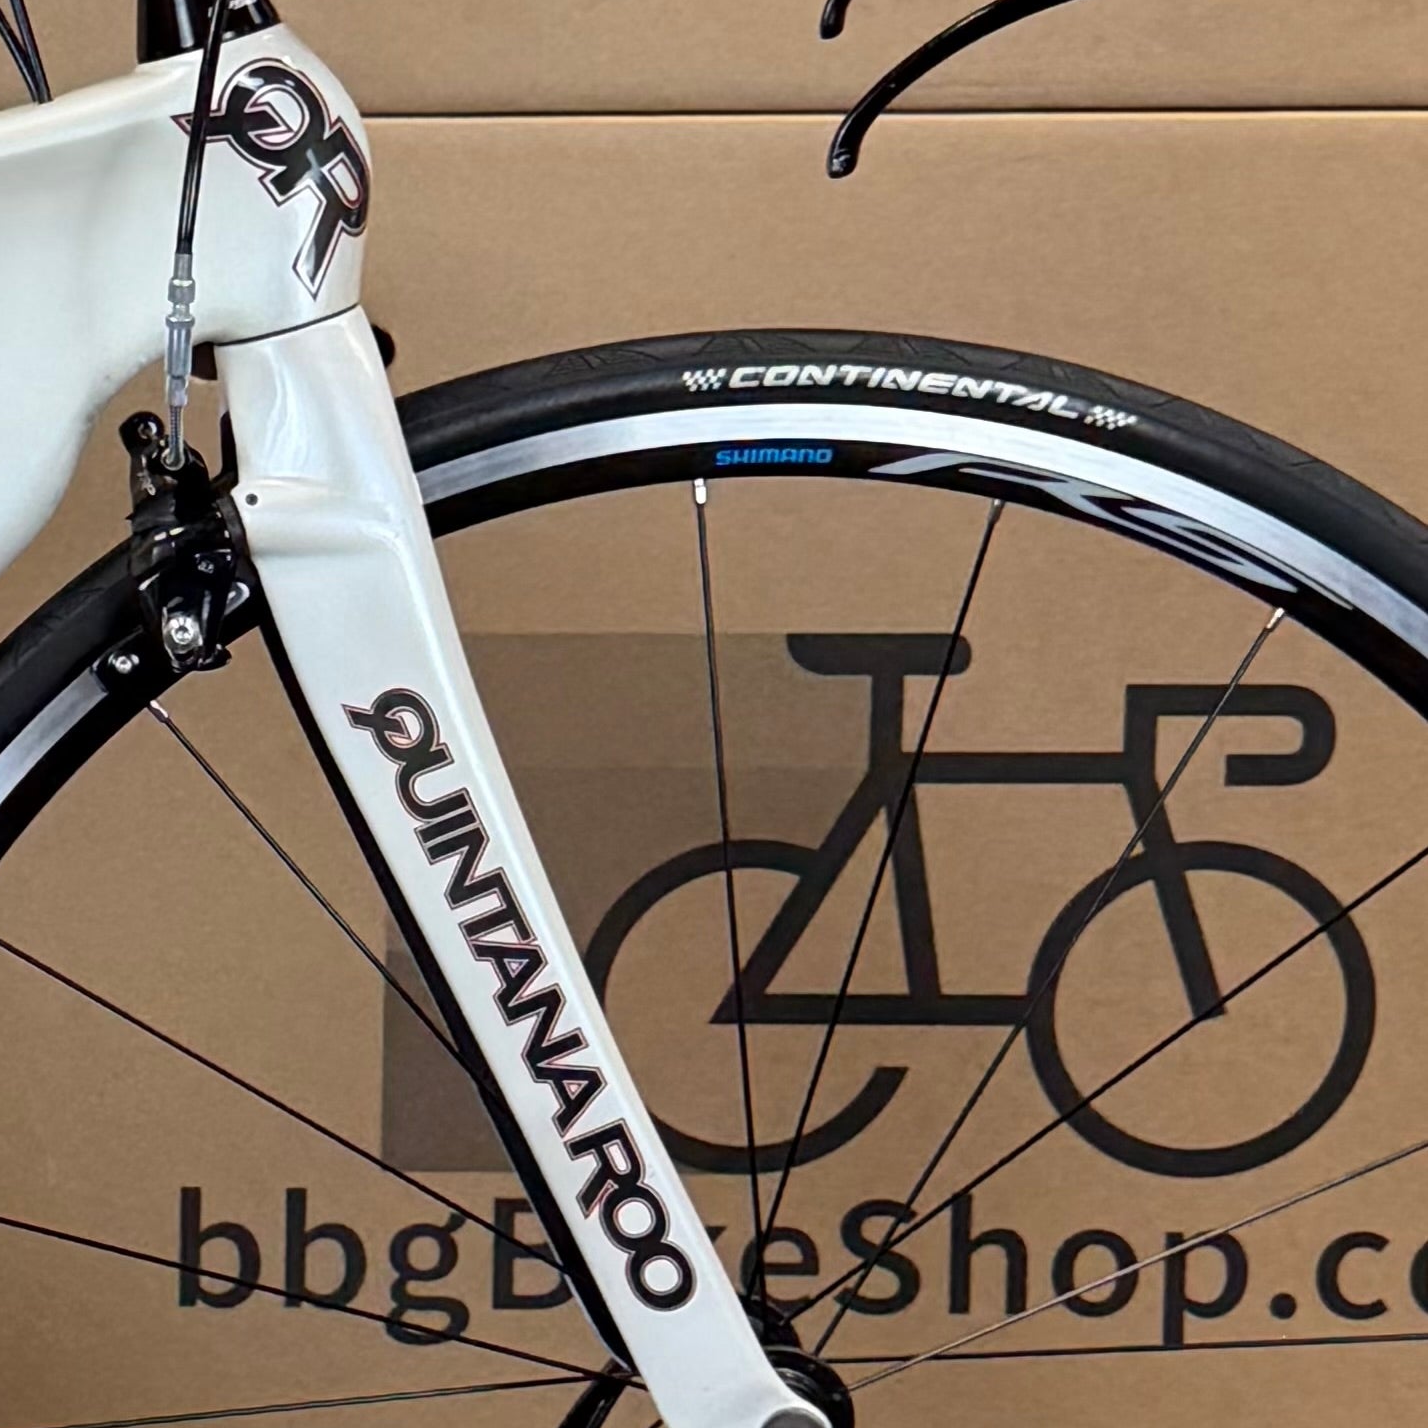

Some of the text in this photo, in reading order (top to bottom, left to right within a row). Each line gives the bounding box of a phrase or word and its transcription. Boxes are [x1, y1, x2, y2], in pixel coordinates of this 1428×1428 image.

[171, 57, 371, 300] QR
[728, 363, 1080, 421] CONTINENTAL
[715, 447, 833, 466] SHIMANO
